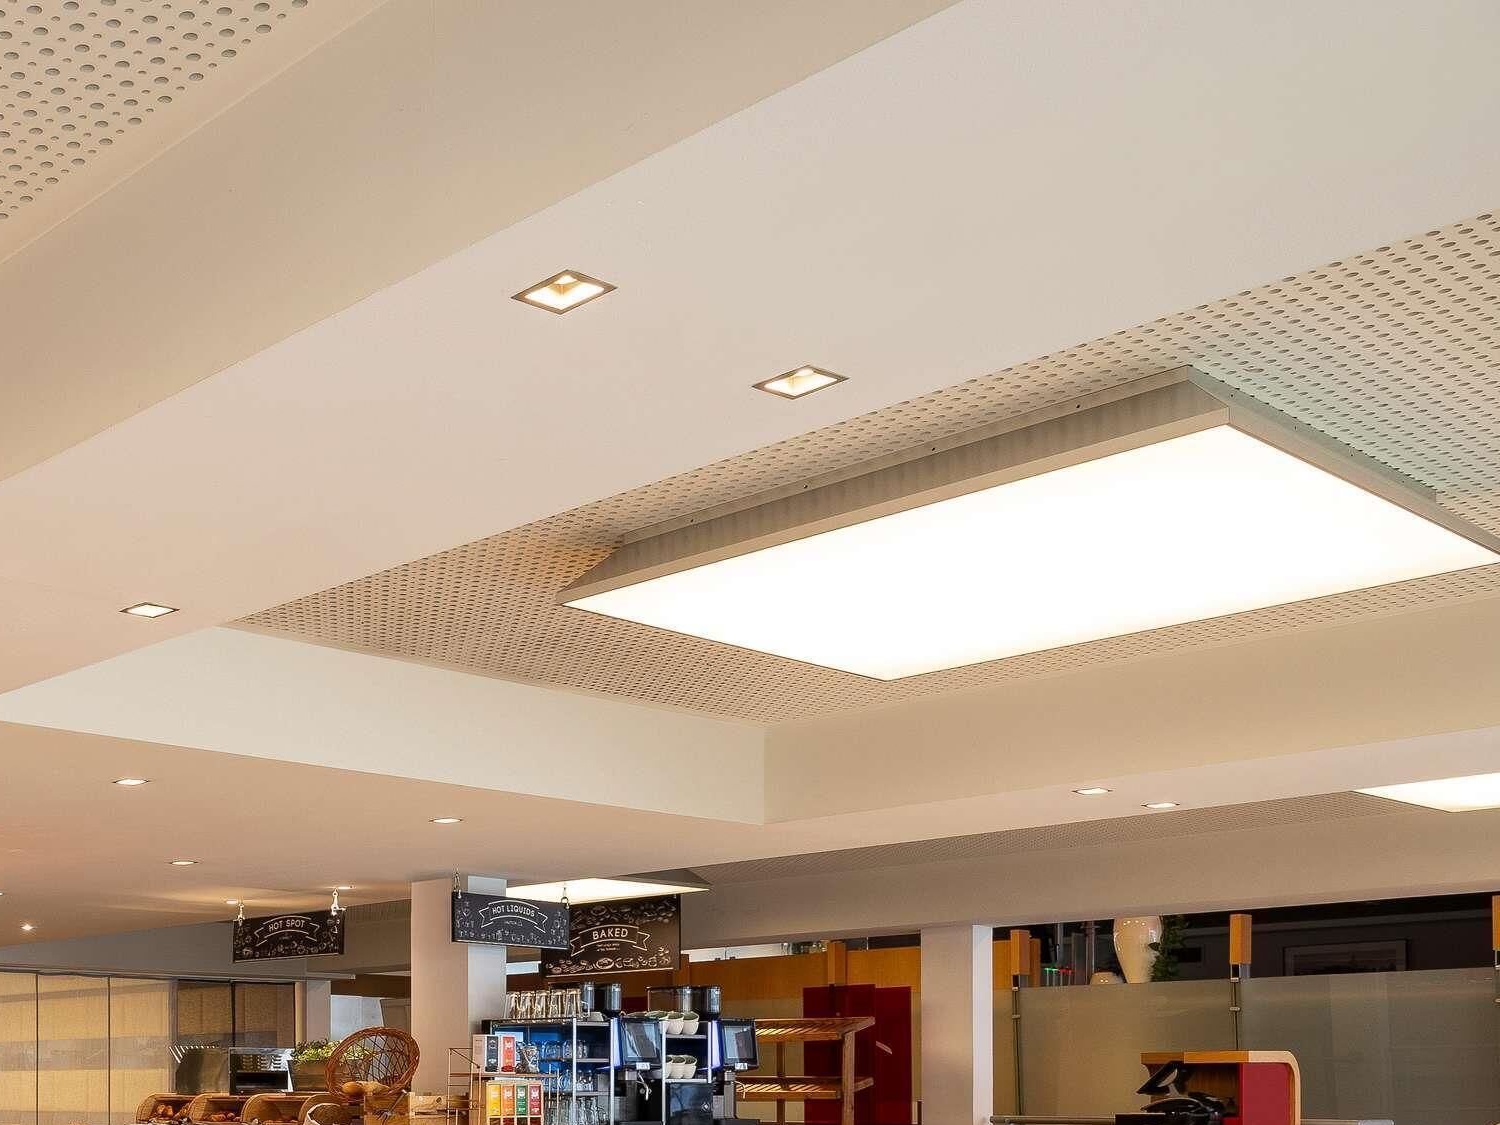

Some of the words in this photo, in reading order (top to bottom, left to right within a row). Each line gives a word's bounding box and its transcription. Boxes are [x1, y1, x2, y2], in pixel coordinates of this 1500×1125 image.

[492, 905, 505, 914] HOT
[506, 904, 535, 917] LIQUIDS
[268, 920, 283, 932] HOT
[286, 919, 305, 928] SPOT
[592, 928, 628, 940] BAKED
